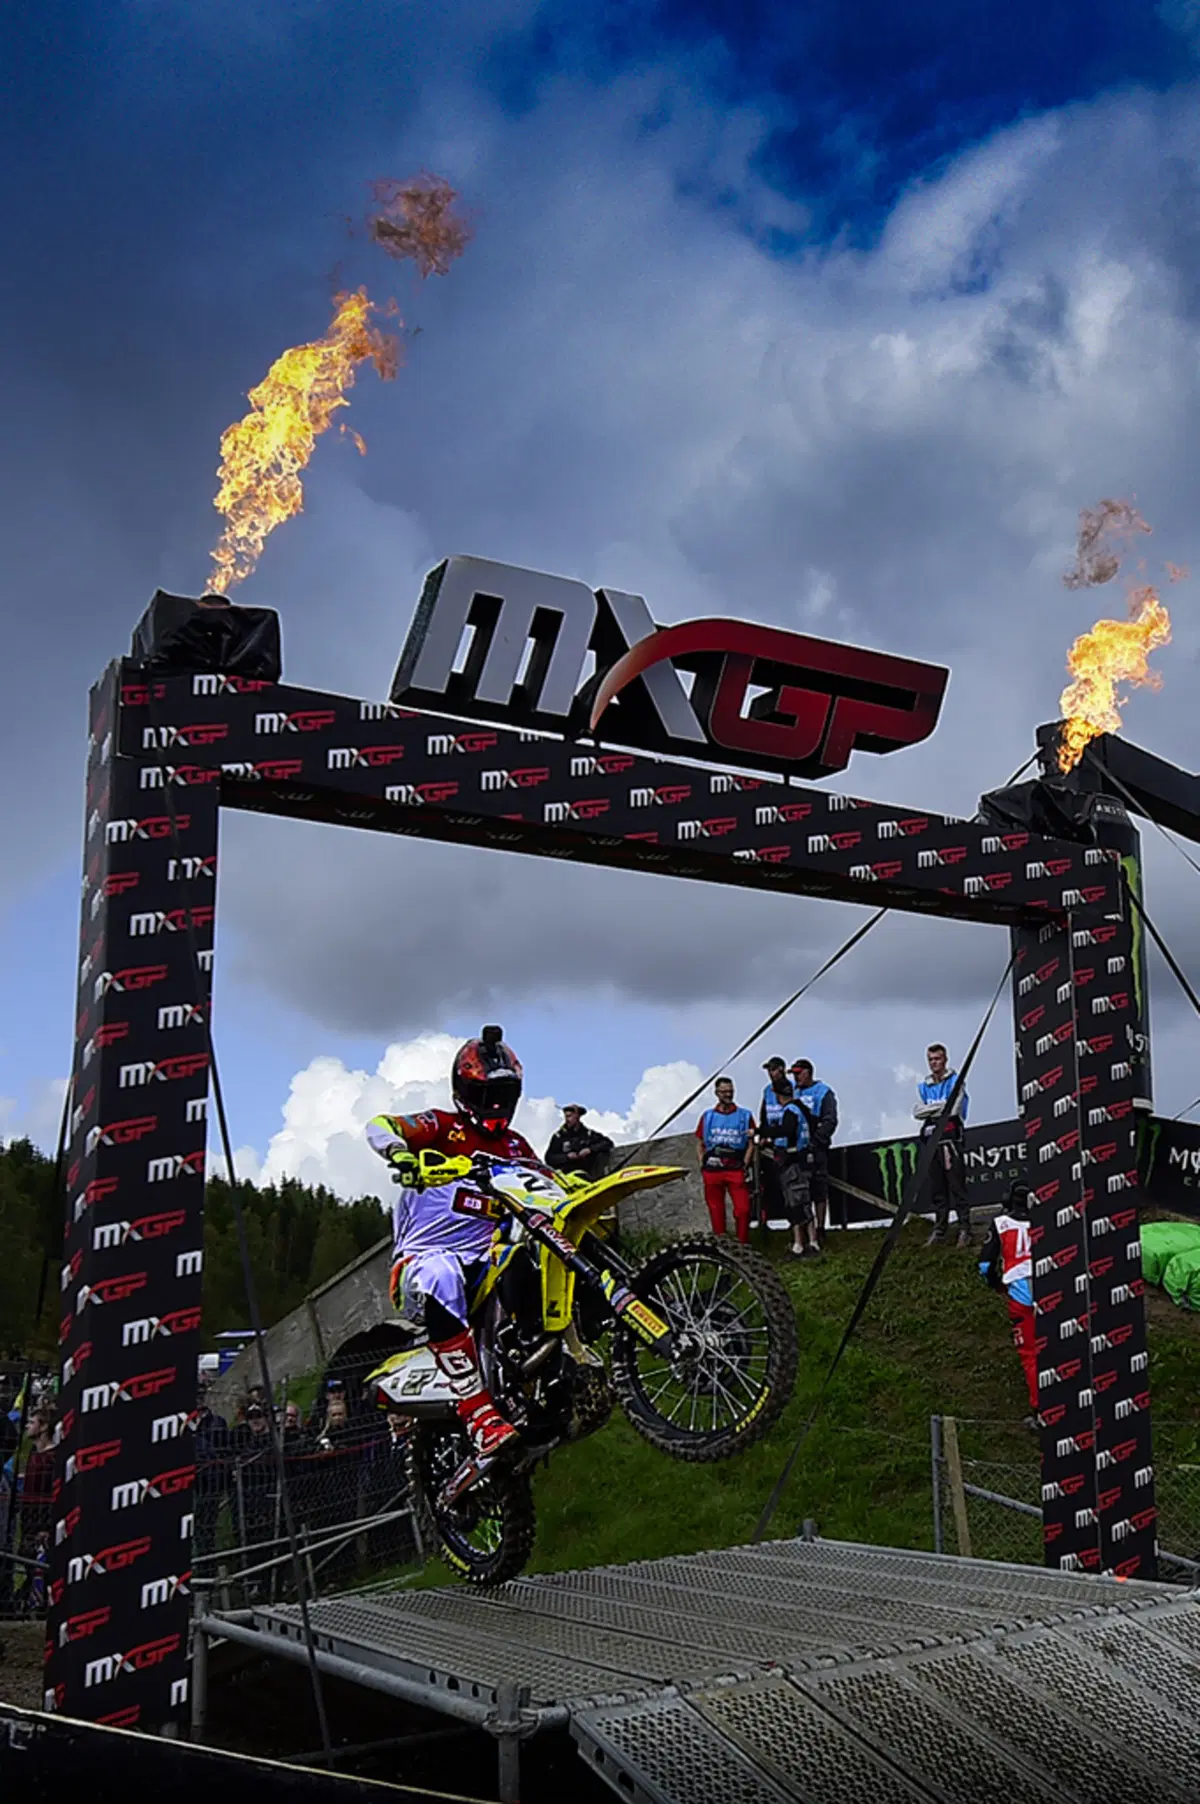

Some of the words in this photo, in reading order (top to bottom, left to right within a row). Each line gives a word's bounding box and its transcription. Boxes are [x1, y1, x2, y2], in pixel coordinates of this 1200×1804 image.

[410, 554, 948, 768] MXGP
[254, 710, 336, 734] MXGP
[142, 724, 229, 749] MXGP
[427, 732, 497, 755] MXGP
[327, 746, 405, 769] MXGP
[571, 755, 635, 777] MXGP
[140, 765, 221, 789] MXGP
[481, 768, 549, 791] MXGP
[385, 782, 459, 804] MXGP
[630, 785, 692, 807] MXGP
[544, 800, 610, 823] MXGP
[755, 804, 812, 825] MXGP
[105, 815, 191, 845] MXGP
[677, 817, 737, 840] MXGP
[878, 818, 928, 839] MXGP
[808, 832, 862, 853] MXGP
[981, 833, 1029, 854] MXGP
[918, 847, 967, 868] MXGP
[1026, 859, 1072, 879] MXGP
[850, 861, 902, 881] MXGP
[964, 873, 1012, 896] MXGP
[1062, 886, 1106, 908] MXGP
[1073, 926, 1116, 948] MXGP
[1018, 958, 1060, 996] MXGP
[119, 1053, 210, 1088] MXGP
[1022, 1065, 1064, 1101] MXGP
[1088, 1100, 1133, 1126] MXGP
[1038, 1129, 1080, 1164] MXGP
[93, 1209, 186, 1250] MXGP
[1091, 1208, 1137, 1237] MXGP
[1036, 1244, 1078, 1278] MXGP
[1038, 1358, 1082, 1389] MXGP
[81, 1367, 176, 1413] MXGP
[112, 1464, 196, 1511] MXGP
[1042, 1474, 1085, 1502] MXGP
[1111, 1506, 1159, 1542] MXGP
[85, 1633, 181, 1688] MXGP
